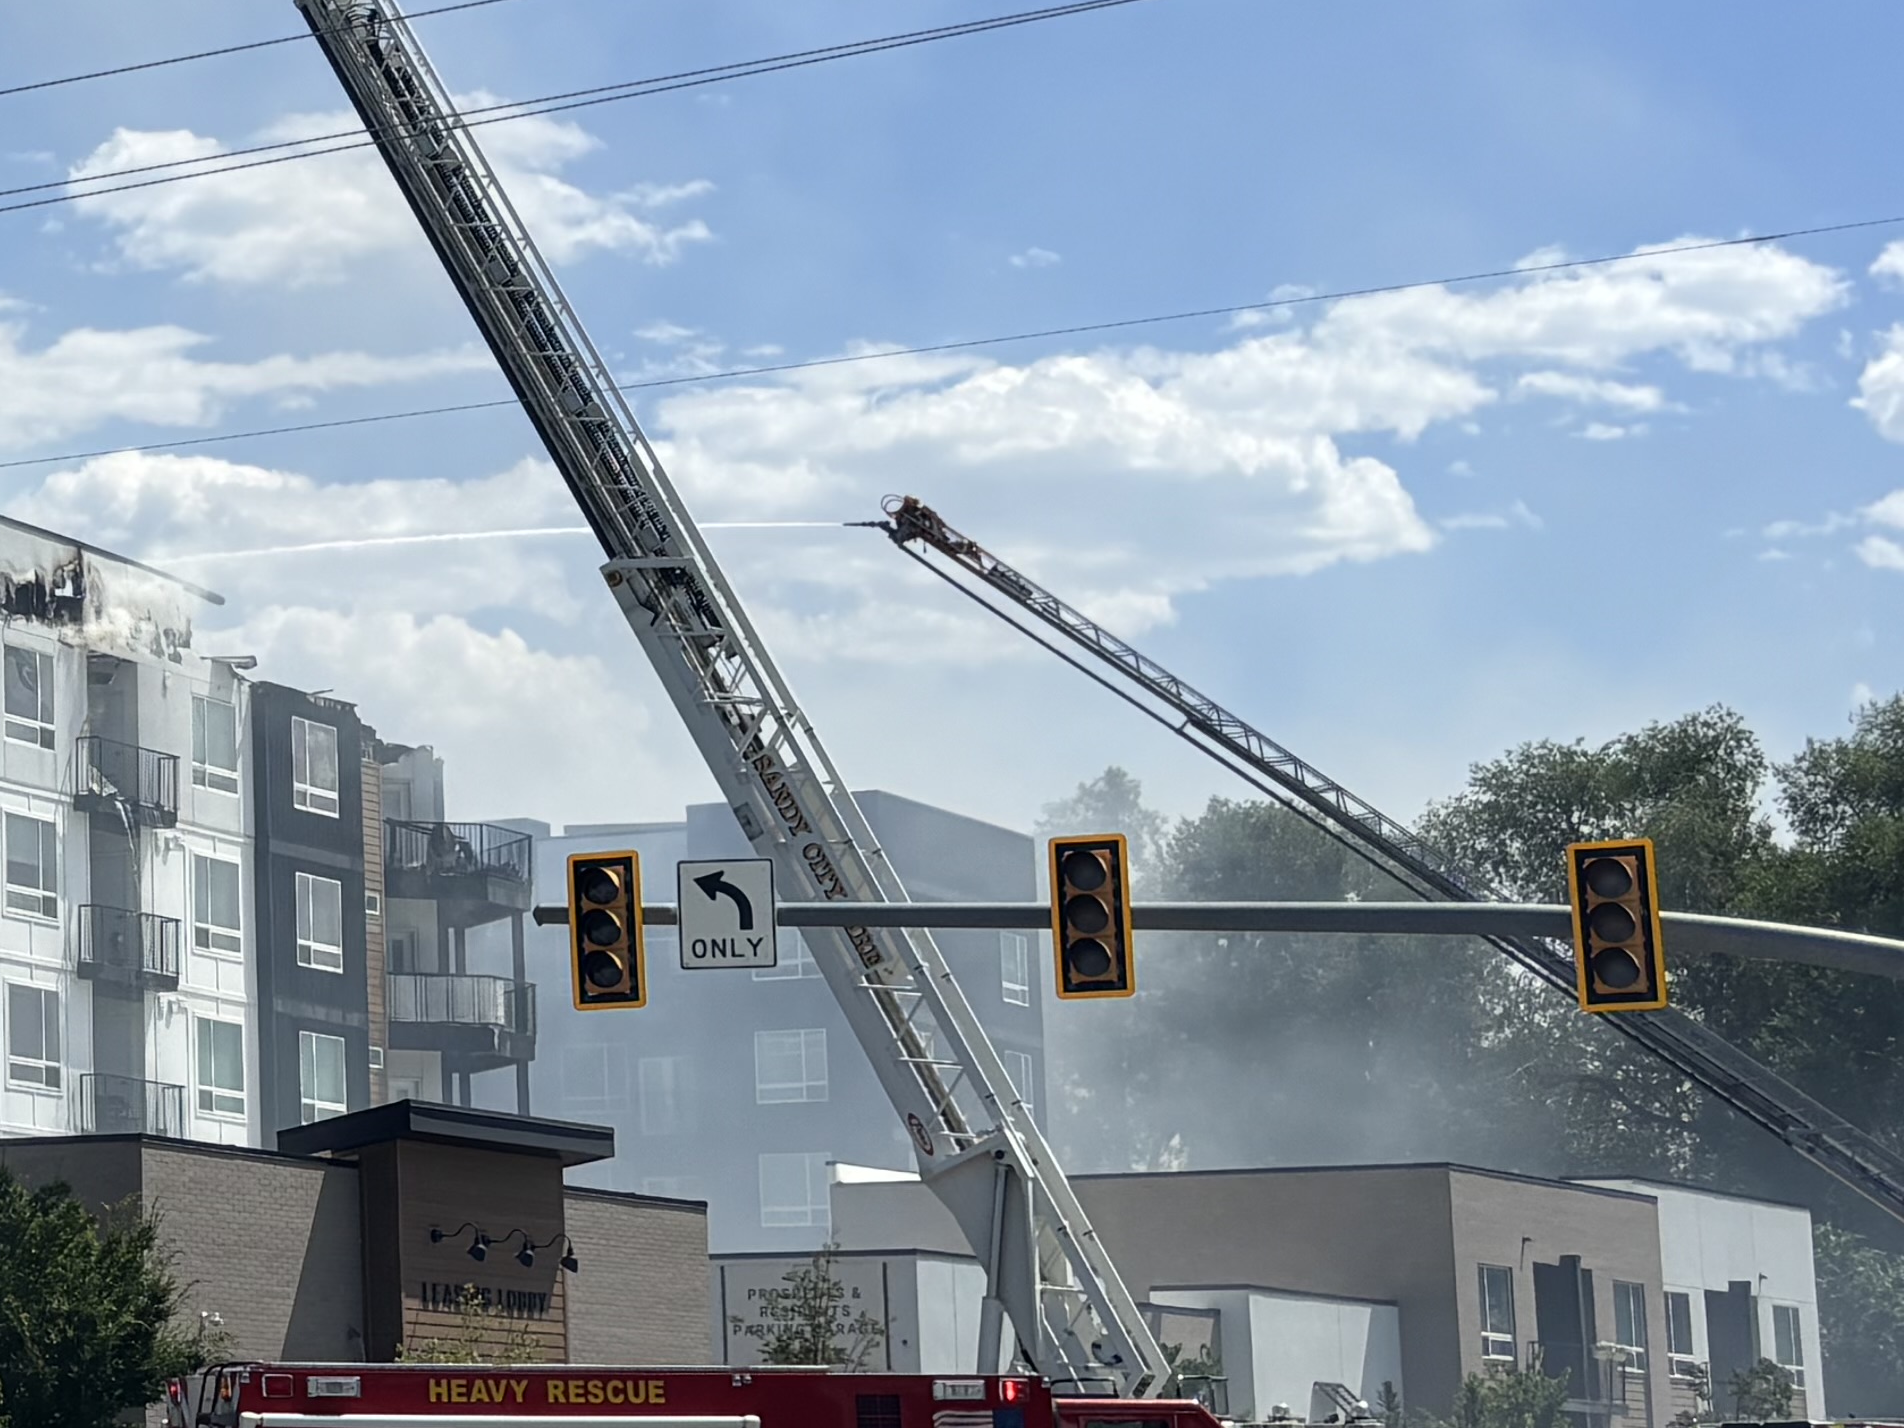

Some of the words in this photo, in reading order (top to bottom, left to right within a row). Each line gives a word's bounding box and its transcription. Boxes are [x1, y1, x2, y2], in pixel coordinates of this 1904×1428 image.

[752, 753, 813, 837] SANDY
[802, 841, 848, 899] CITY
[691, 936, 764, 959] ONLY
[851, 1286, 862, 1300] &
[814, 1322, 882, 1337] ARAGE
[428, 1379, 528, 1405] HEAVY
[547, 1379, 667, 1405] RESCUE
